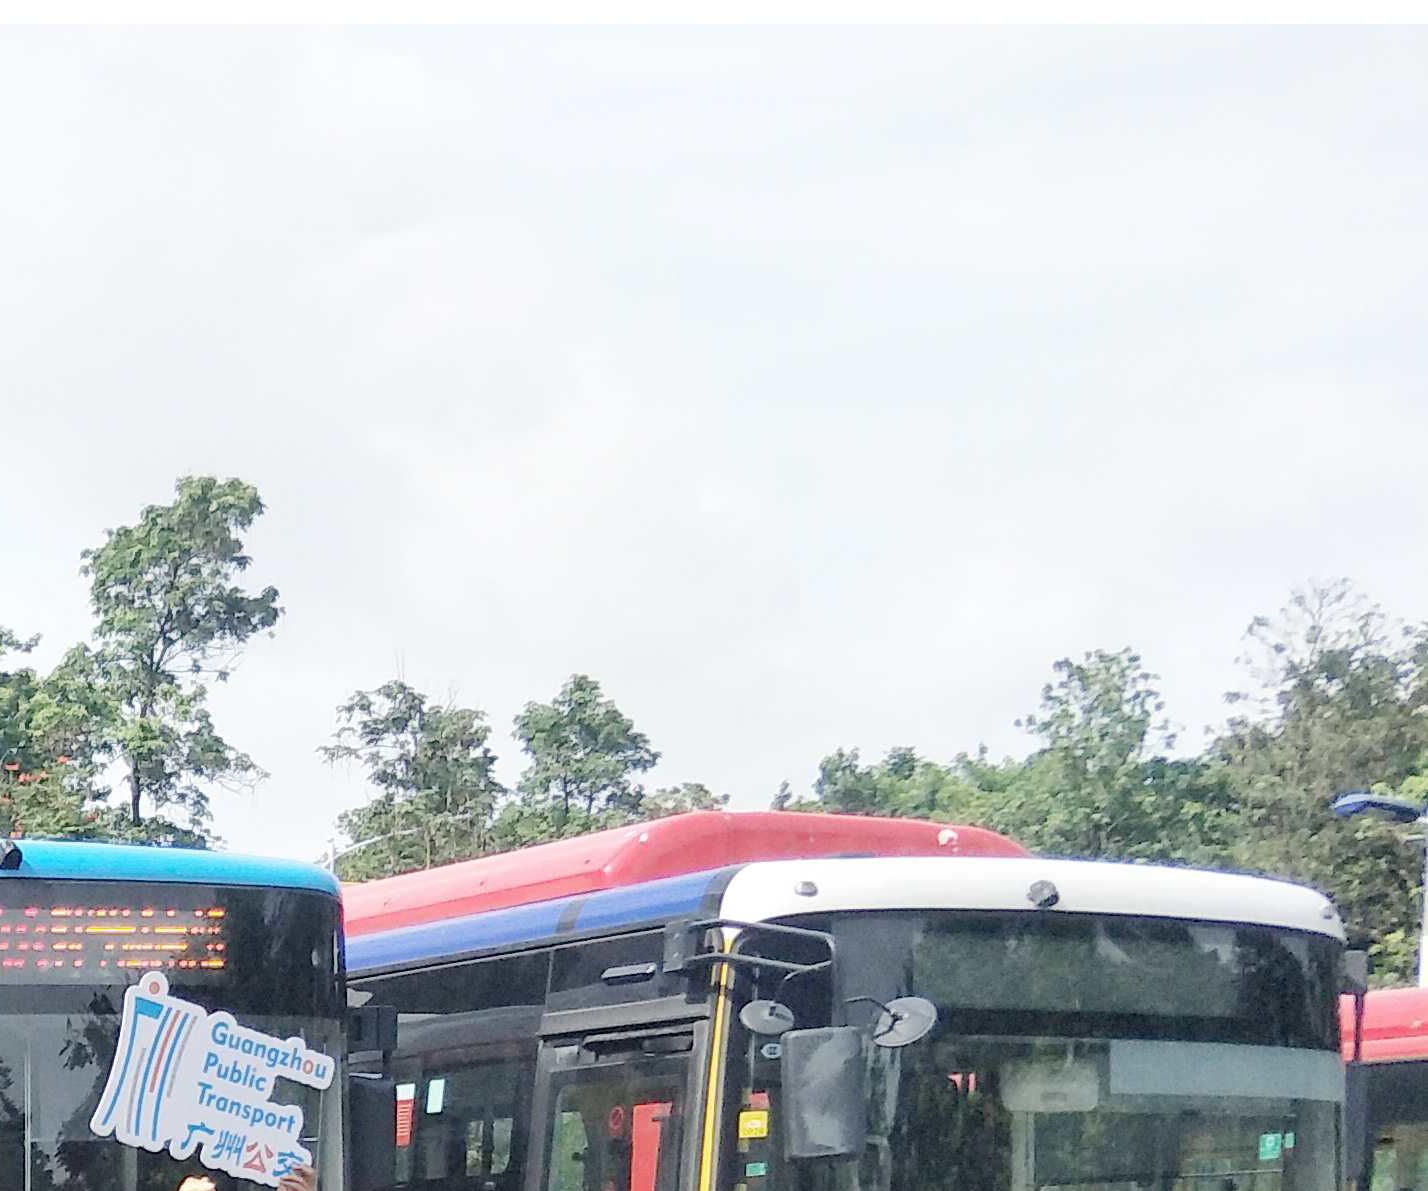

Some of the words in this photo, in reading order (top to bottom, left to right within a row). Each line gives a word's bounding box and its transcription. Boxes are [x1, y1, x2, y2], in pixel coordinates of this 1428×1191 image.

[202, 1051, 267, 1092] Public
[211, 1021, 327, 1080] Guangzhou
[196, 1081, 296, 1134] Transport
